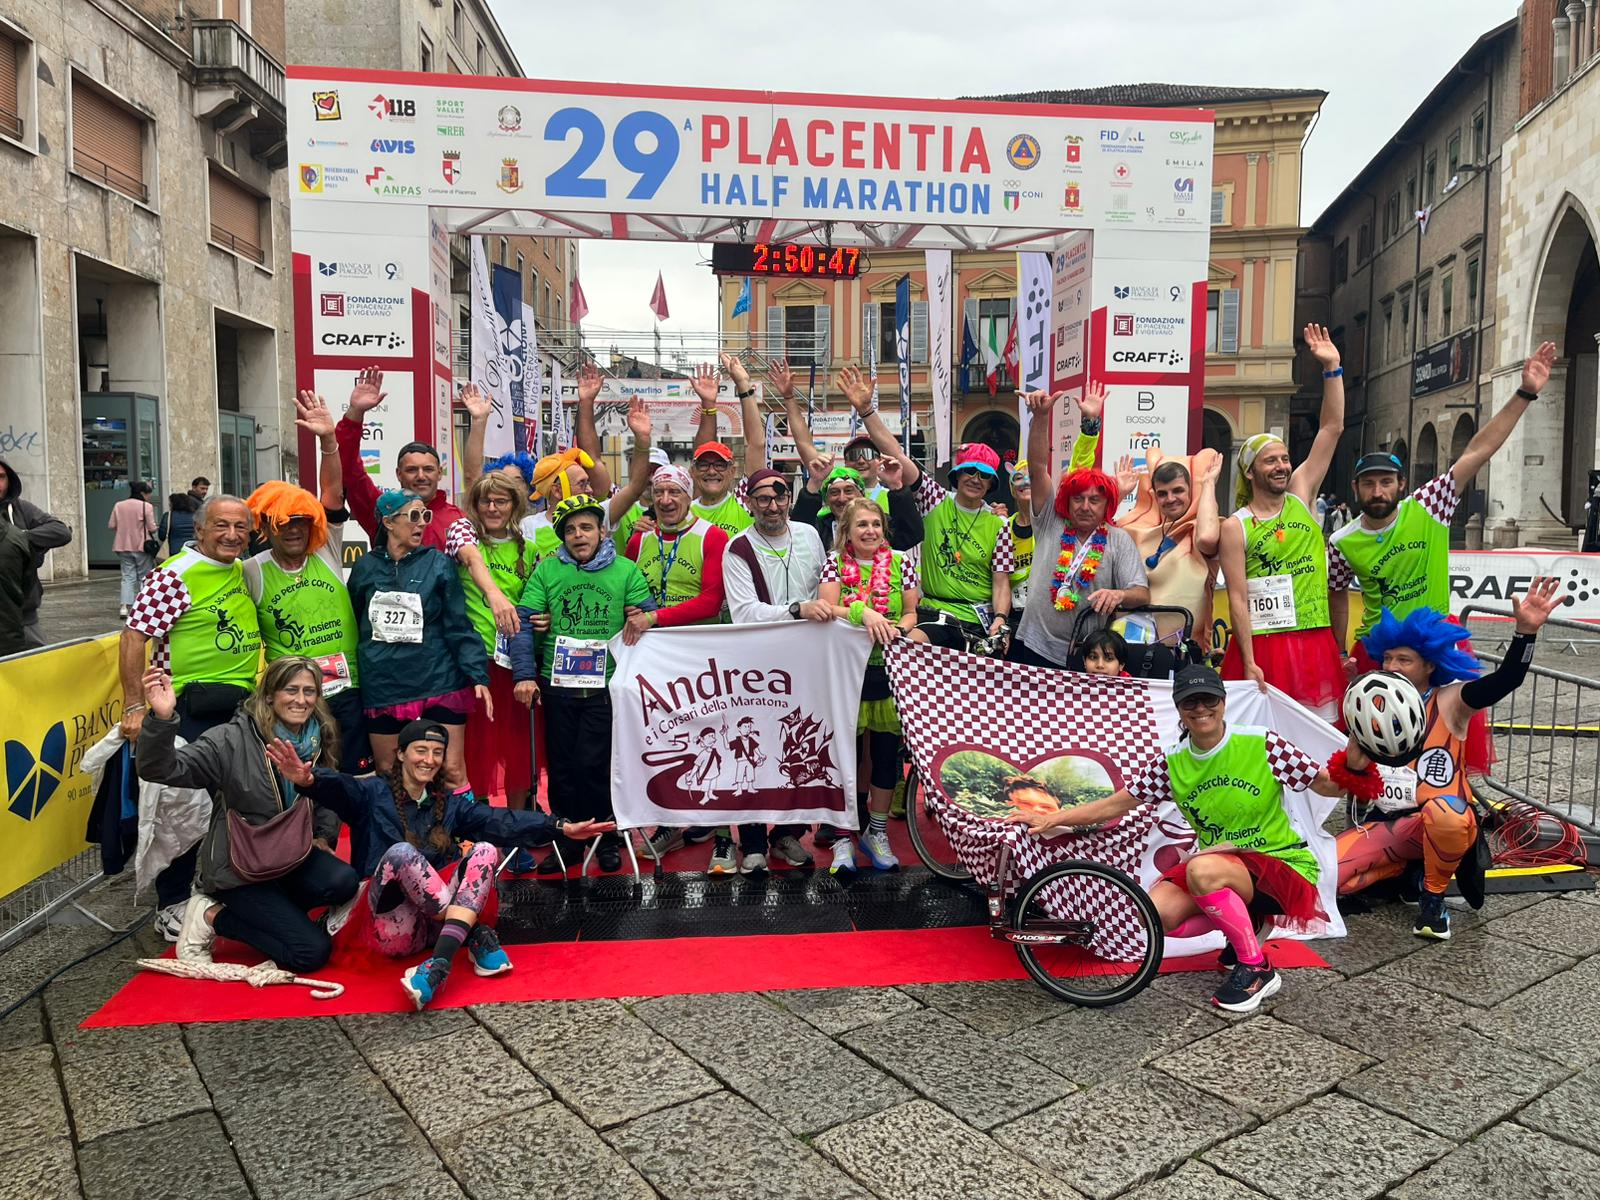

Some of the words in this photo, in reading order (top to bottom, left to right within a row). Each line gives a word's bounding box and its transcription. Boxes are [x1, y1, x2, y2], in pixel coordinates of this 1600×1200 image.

[388, 99, 416, 117] 118
[436, 99, 465, 108] SPORT
[436, 106, 465, 114] VALLEY
[447, 126, 465, 137] RER
[370, 139, 416, 154] AVIS
[701, 114, 991, 174] PLACENTIA
[543, 107, 681, 200] 29
[1166, 159, 1204, 167] EMILIA
[383, 185, 422, 196] ANPAS
[701, 173, 790, 207] HALF
[803, 176, 991, 214] MARATHON
[1021, 190, 1044, 199] CONI
[752, 243, 862, 275] 2:50:47
[347, 296, 405, 305] FONDAZIONE
[1136, 317, 1185, 325] FONDAZIONE
[322, 333, 387, 347] CRAFT
[1056, 355, 1076, 372] CRAFT
[1112, 351, 1168, 363] CRAFT
[342, 404, 389, 413] BONI
[1126, 415, 1166, 424] BOSSONI
[362, 428, 384, 440] en
[1129, 437, 1161, 450] iren
[719, 523, 739, 534] corro
[1254, 541, 1264, 553] so
[1287, 521, 1311, 533] corro
[971, 540, 987, 558] corro
[677, 557, 697, 575] corro
[1370, 564, 1381, 576] so
[1378, 543, 1406, 566] perchè
[271, 594, 282, 605] so
[280, 577, 310, 597] perchè
[311, 579, 335, 593] corro
[563, 587, 572, 596] so
[571, 583, 597, 592] perchè
[595, 586, 613, 602] corro
[1449, 575, 1562, 600] RAF
[215, 597, 225, 605] so
[1252, 597, 1280, 612] 1601
[384, 611, 407, 625] 327
[583, 619, 610, 627] insieme
[308, 618, 342, 634] insieme
[568, 627, 576, 635] al
[576, 627, 610, 635] traguardo
[294, 641, 303, 651] al
[303, 630, 344, 649] traguardo
[232, 646, 242, 655] al
[635, 658, 792, 727] Andrea
[72, 699, 124, 746] BANC
[645, 736, 654, 746] e
[652, 730, 660, 740] i
[658, 706, 699, 734] Corsari
[700, 699, 728, 716] della
[730, 695, 789, 709] Maratona
[67, 788, 77, 802] 90
[1188, 789, 1199, 802] so
[1198, 774, 1231, 793] perchè
[1231, 777, 1261, 797] corro
[1225, 825, 1262, 840] insieme
